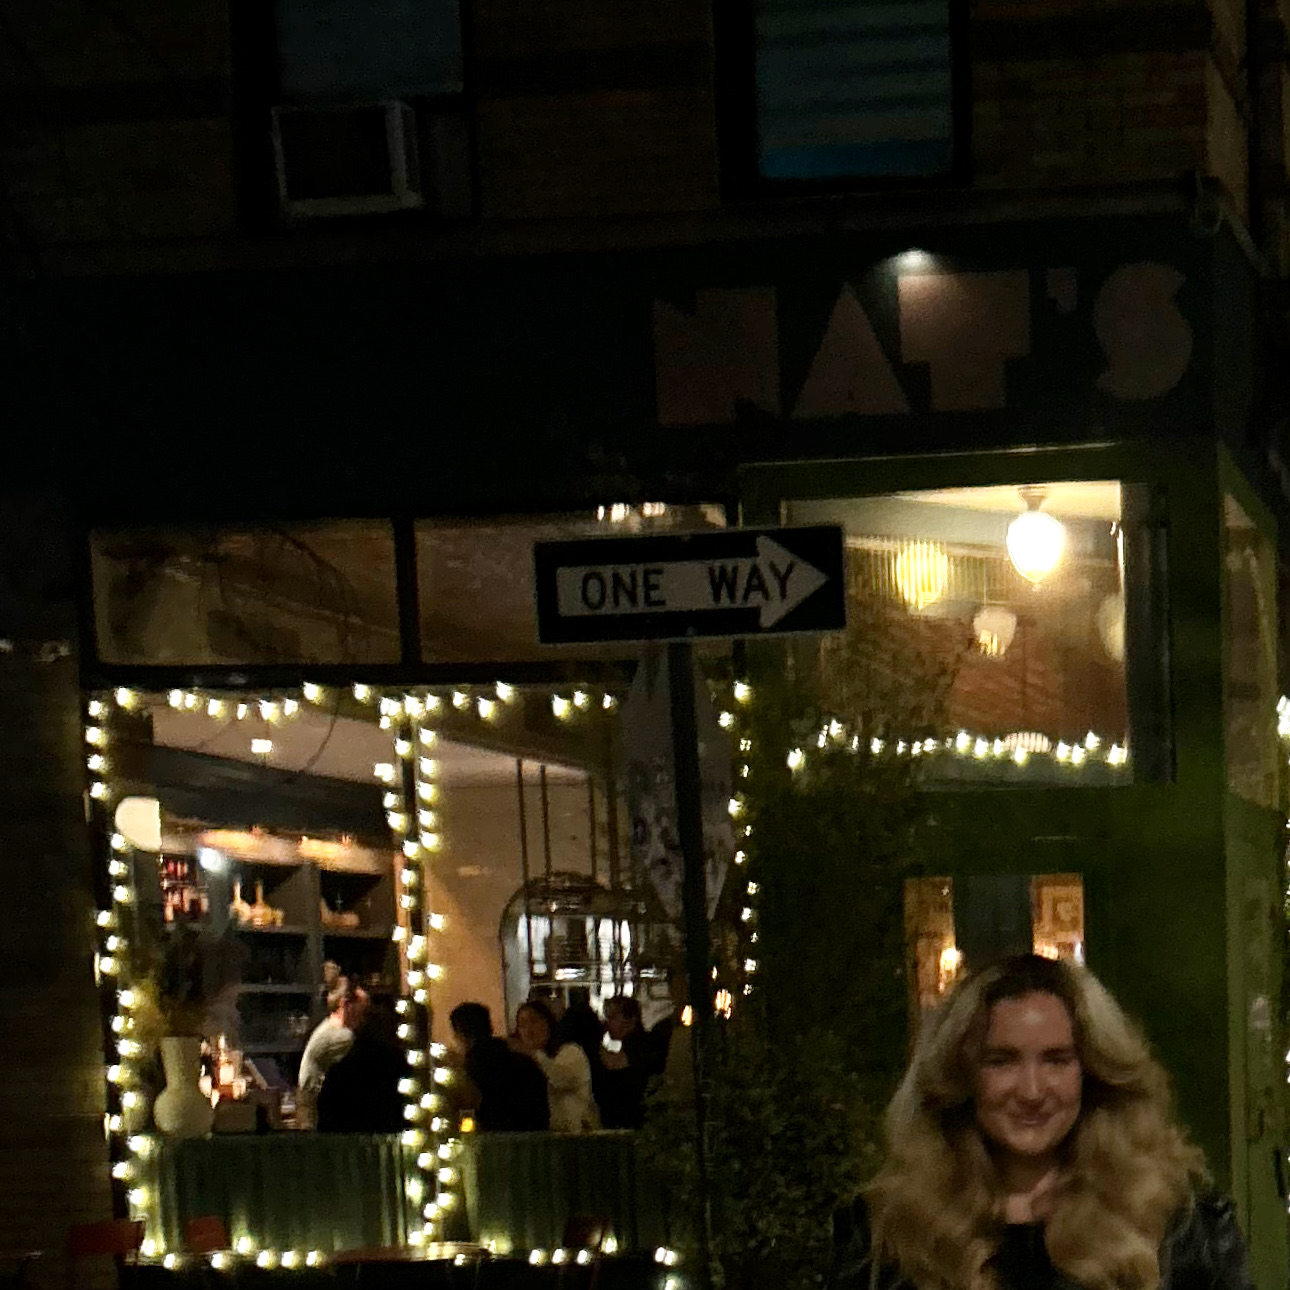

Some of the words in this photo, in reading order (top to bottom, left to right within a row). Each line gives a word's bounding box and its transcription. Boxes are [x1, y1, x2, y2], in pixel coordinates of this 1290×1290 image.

[652, 261, 1194, 426] NAT'S
[581, 568, 667, 611] ONE
[708, 561, 795, 604] WAY
